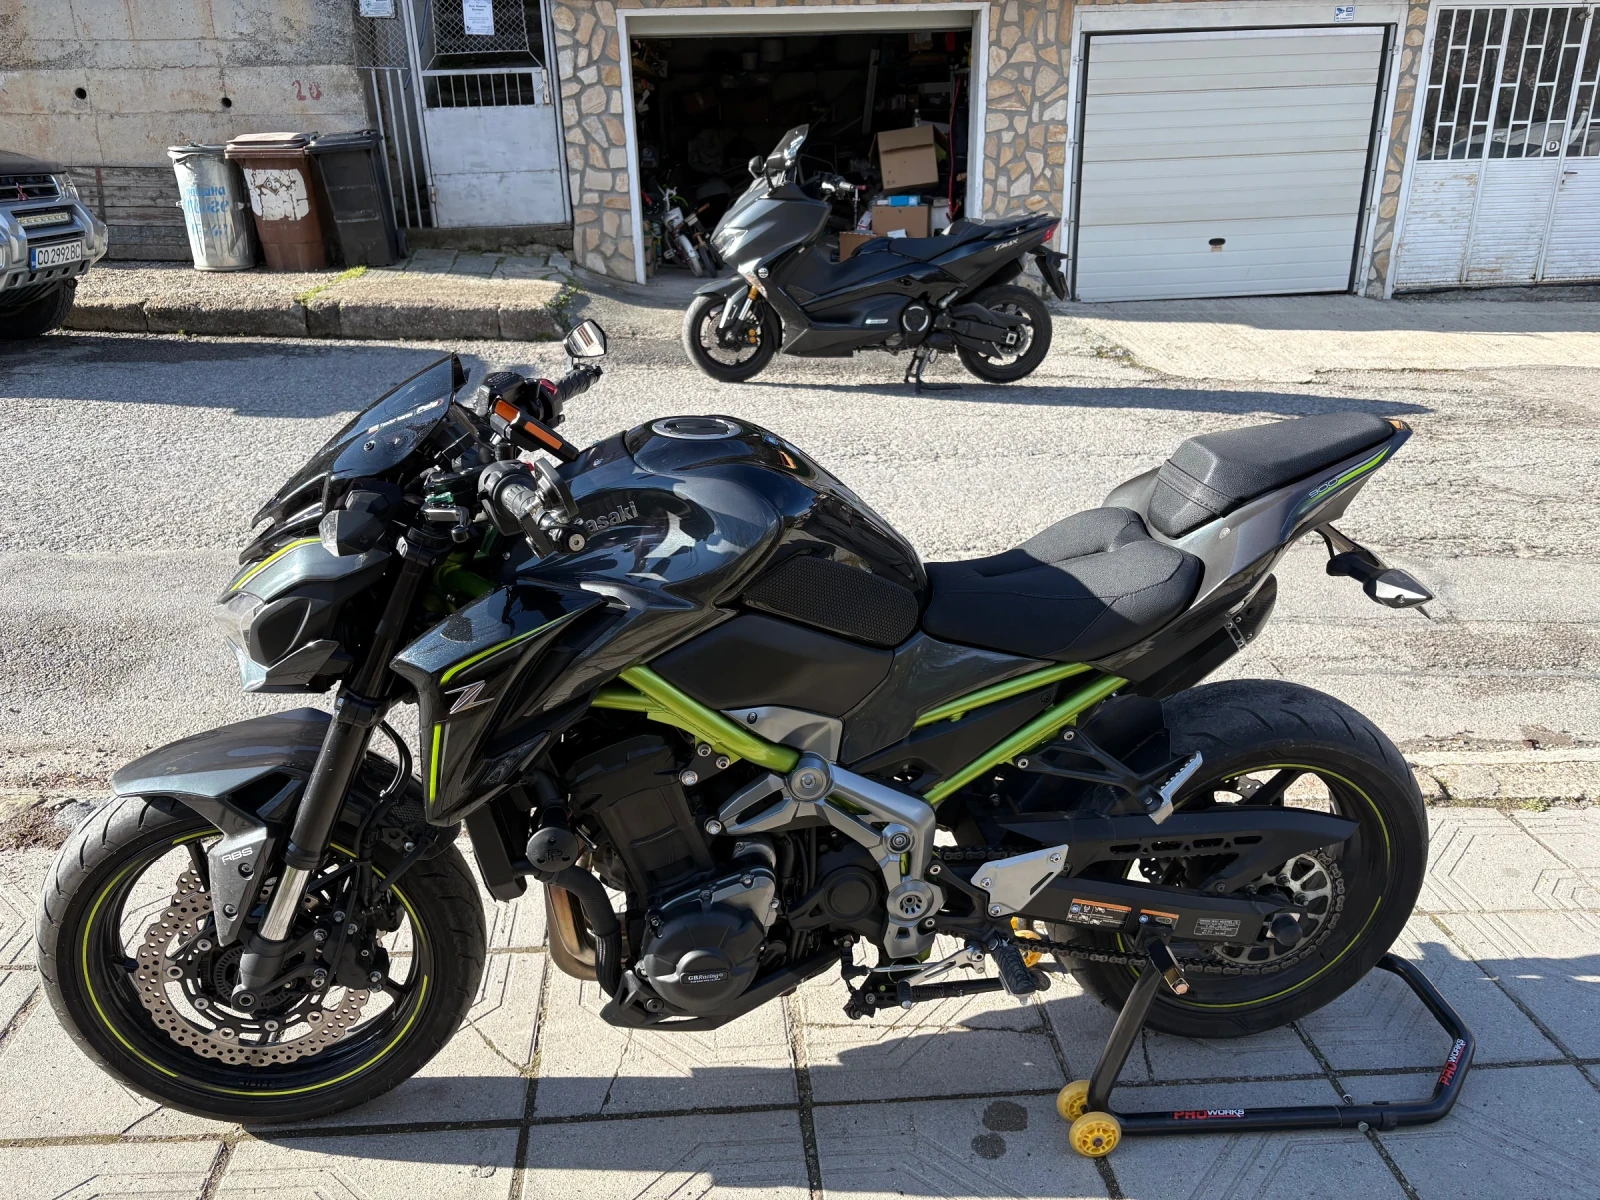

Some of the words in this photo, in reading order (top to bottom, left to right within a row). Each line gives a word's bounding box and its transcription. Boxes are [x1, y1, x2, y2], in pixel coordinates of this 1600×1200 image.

[1309, 478, 1337, 499] 900
[586, 501, 638, 532] asaki
[222, 847, 253, 865] ABS
